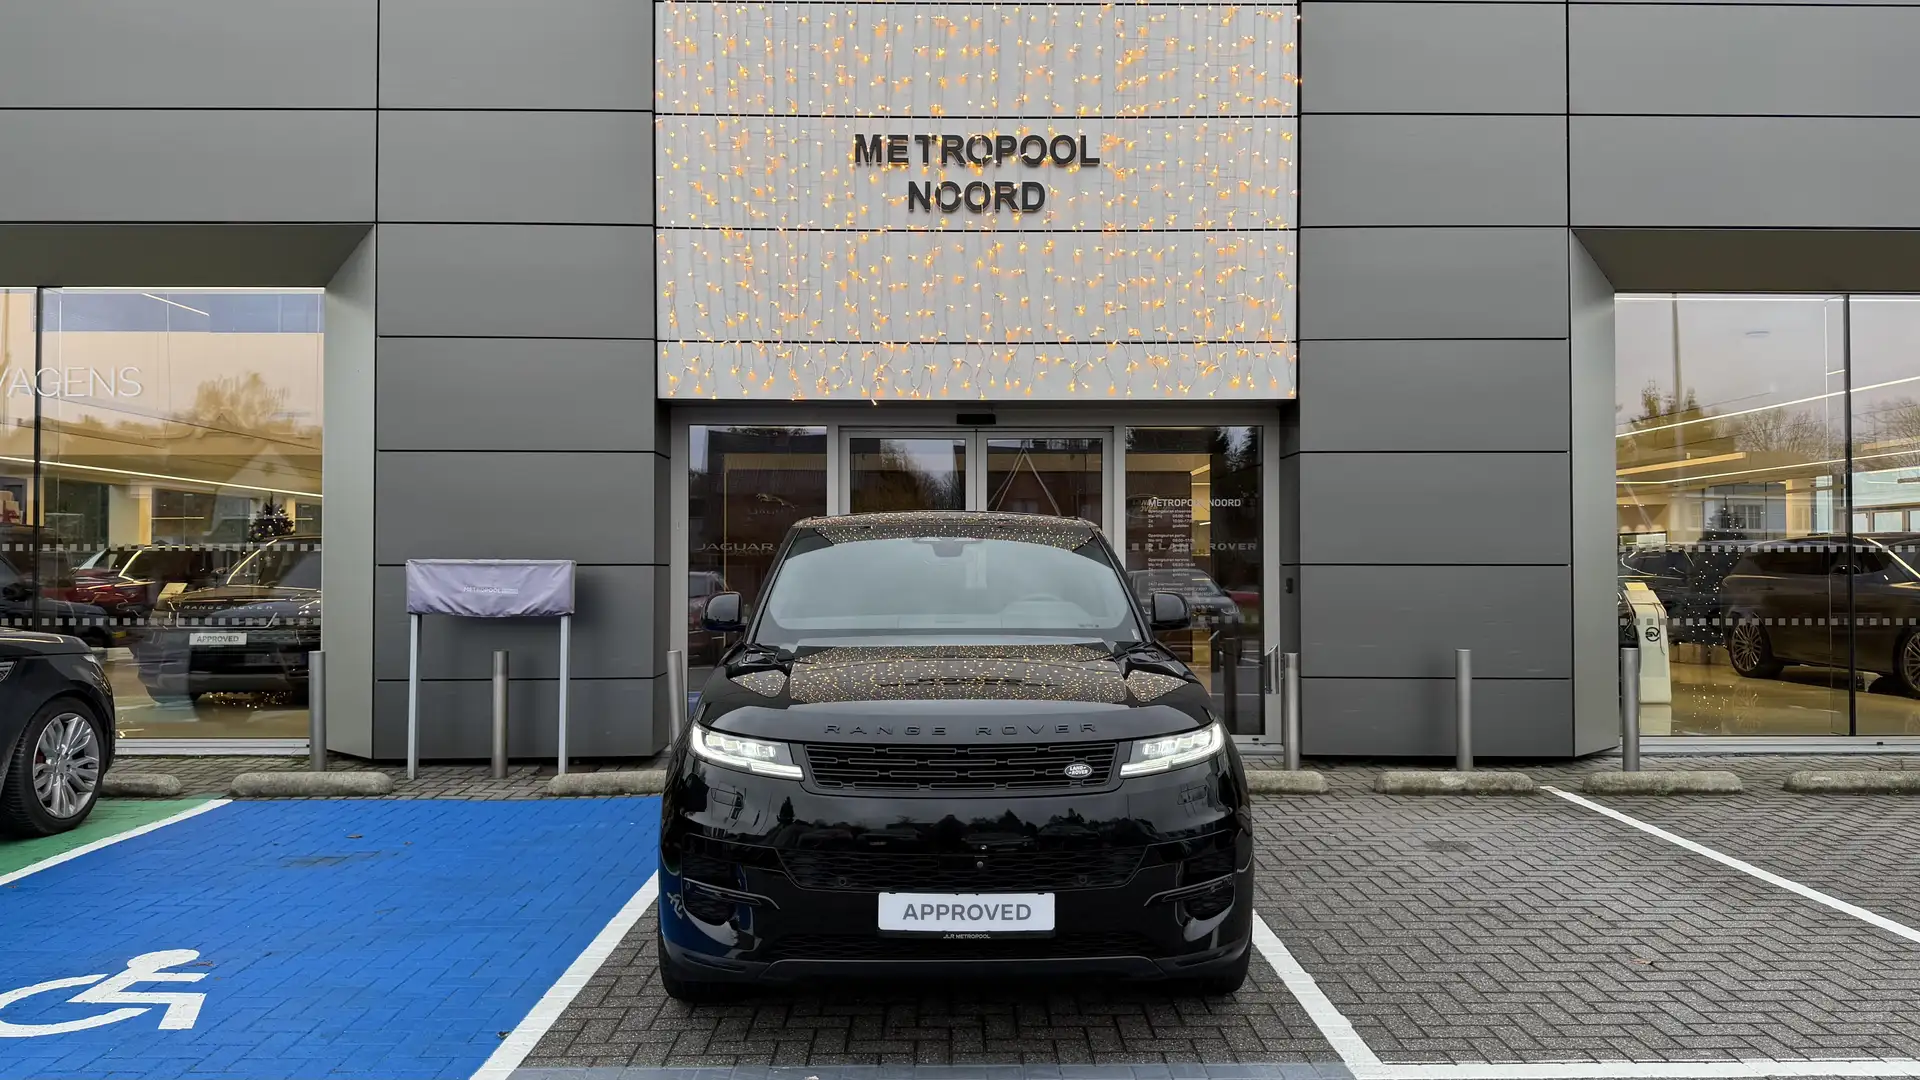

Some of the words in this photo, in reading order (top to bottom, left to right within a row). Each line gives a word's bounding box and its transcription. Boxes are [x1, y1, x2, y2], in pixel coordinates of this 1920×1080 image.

[854, 133, 1101, 167] METROPOOL
[907, 180, 1046, 213] NOORD
[694, 542, 774, 551] JAGUAR
[196, 635, 240, 643] APPROVED
[823, 723, 947, 736] RANGE
[975, 722, 1097, 736] ROVER
[902, 903, 1032, 921] APPROVED
